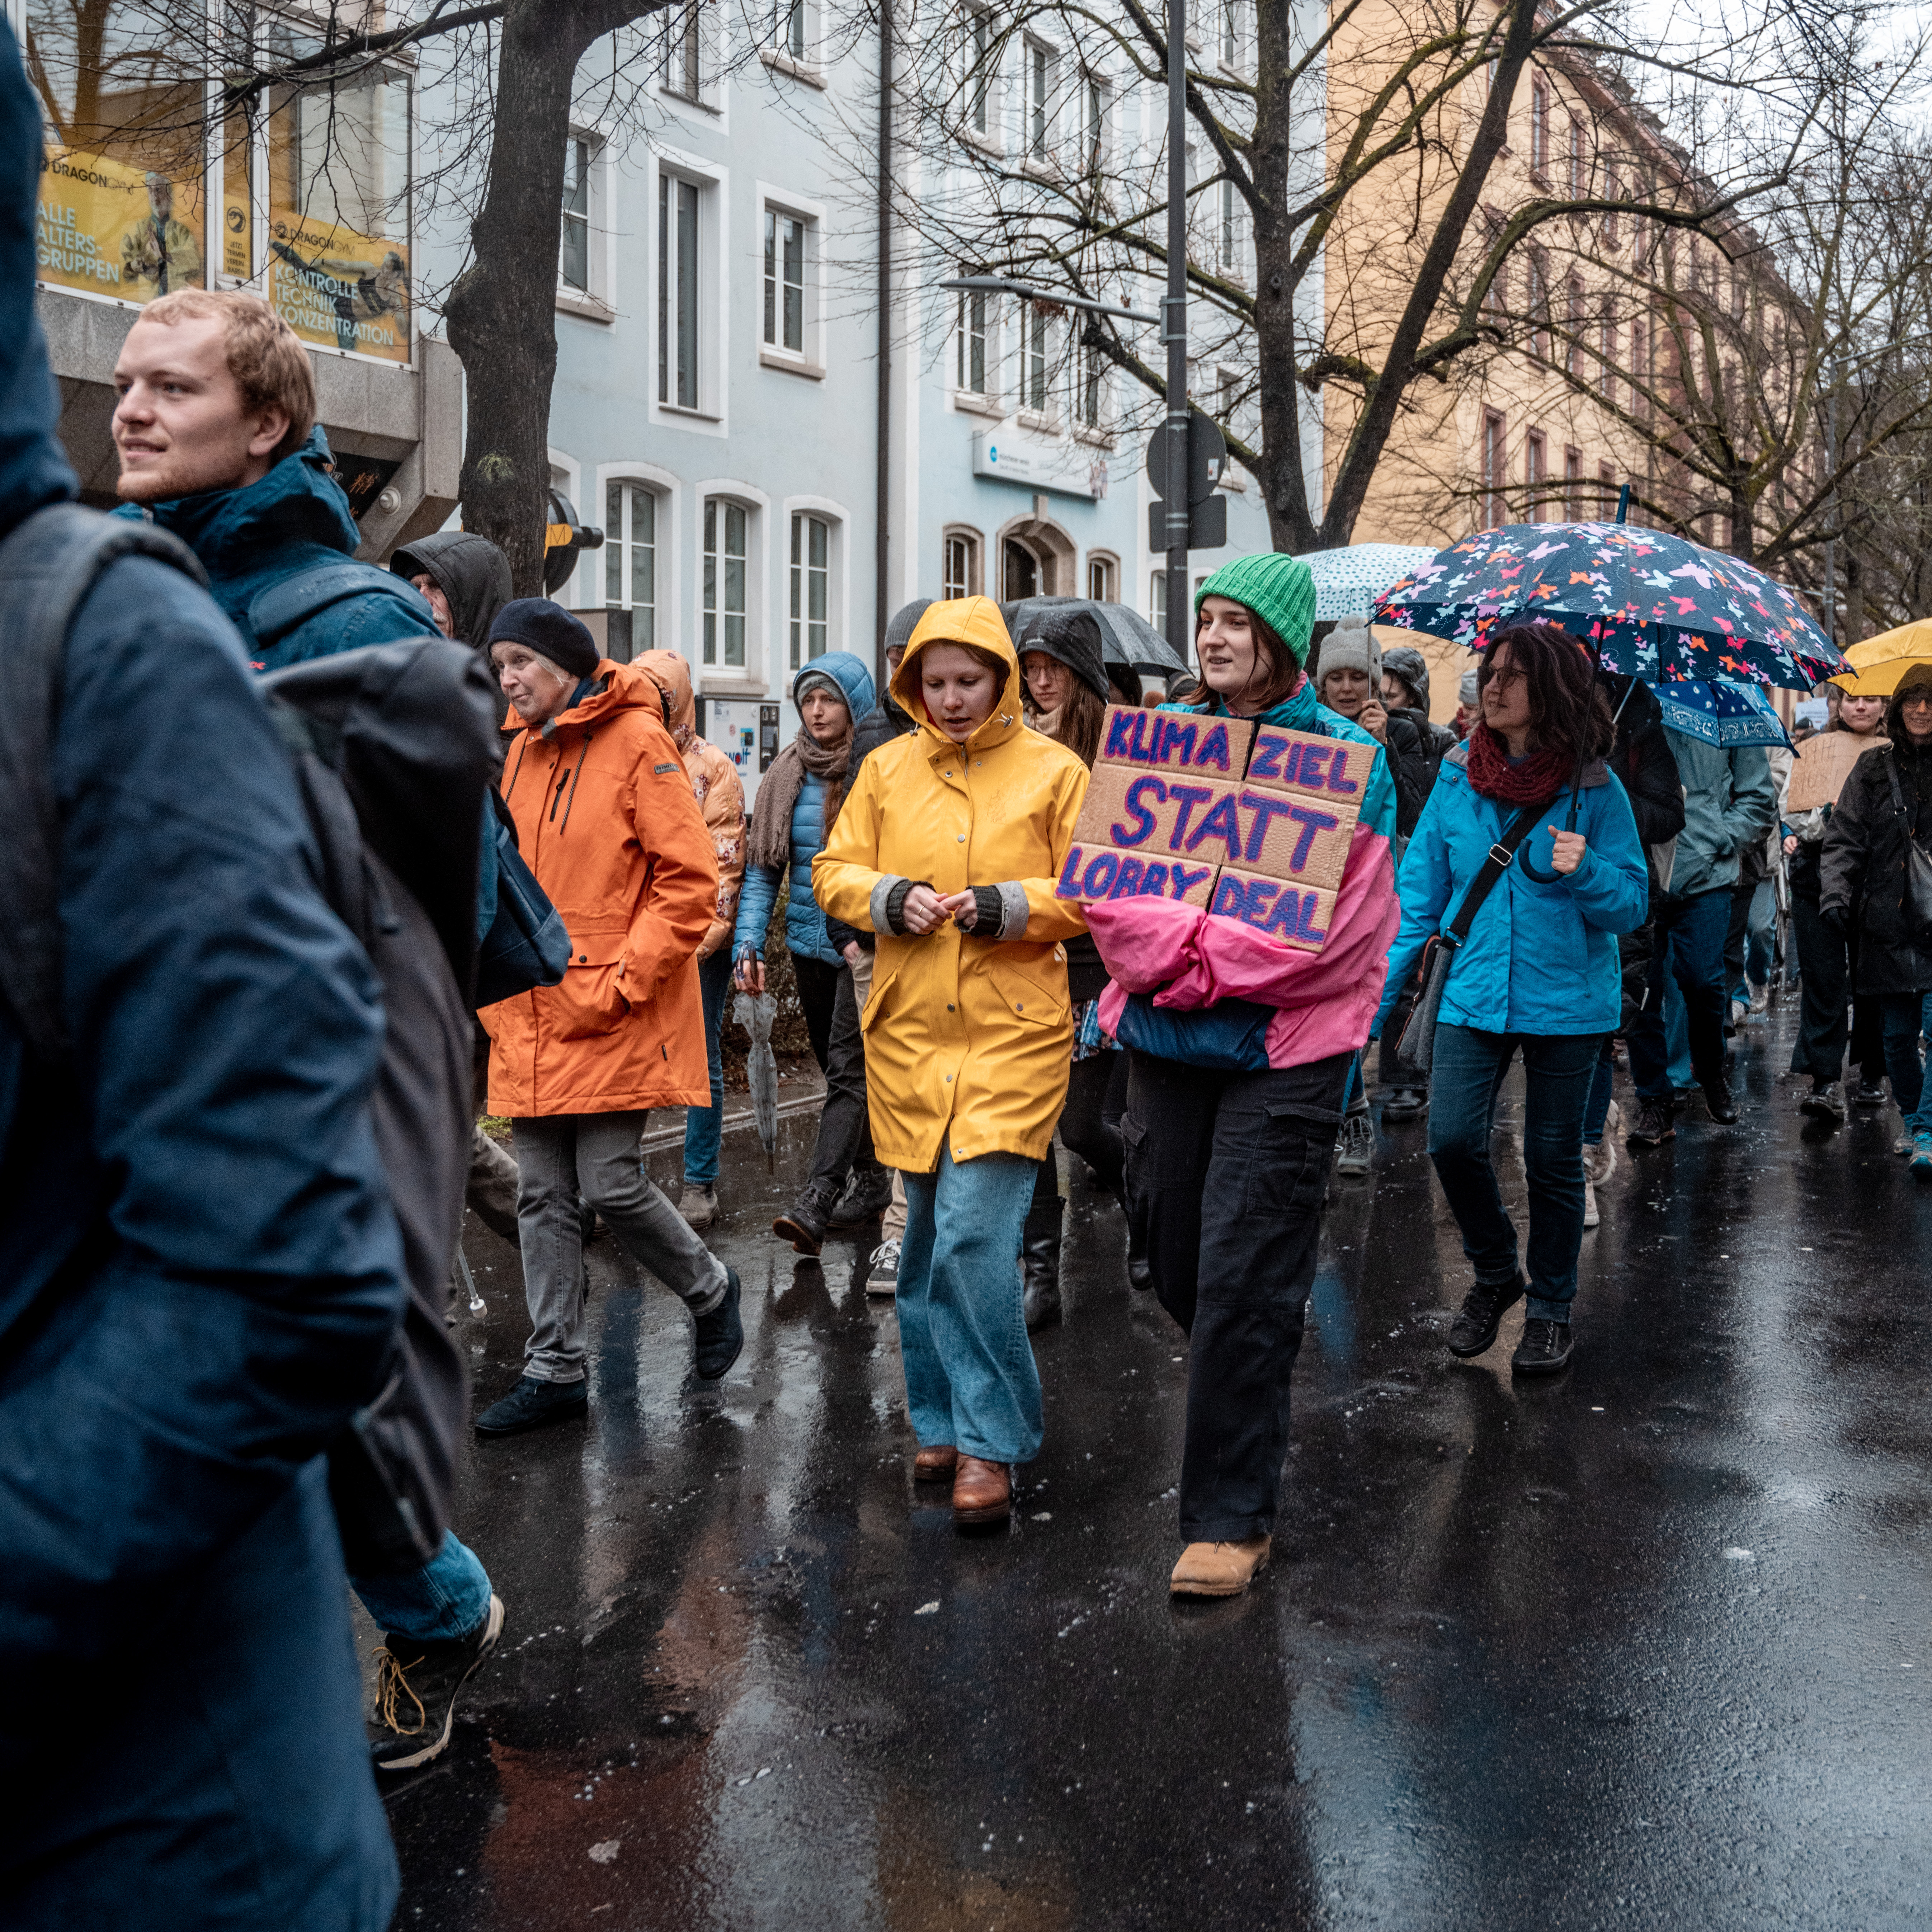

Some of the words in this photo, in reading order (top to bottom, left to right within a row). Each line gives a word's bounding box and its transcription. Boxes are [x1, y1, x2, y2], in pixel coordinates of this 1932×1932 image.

[36, 200, 75, 227] ALLE
[36, 222, 103, 255] ALTERS-
[227, 248, 245, 258] TERMIN
[290, 228, 355, 255] DRAGONGYM
[36, 245, 119, 283] GRUPPEN
[275, 262, 358, 300] KONTROLLE
[275, 283, 338, 314] TECHNIK
[275, 303, 393, 345] KONZENTRATION
[1104, 709, 1230, 772] KLIMA
[1247, 734, 1358, 794] ZIEL
[1109, 776, 1339, 872] STATT
[1054, 846, 1211, 901] LOBBY
[1211, 874, 1327, 944] DEAL
